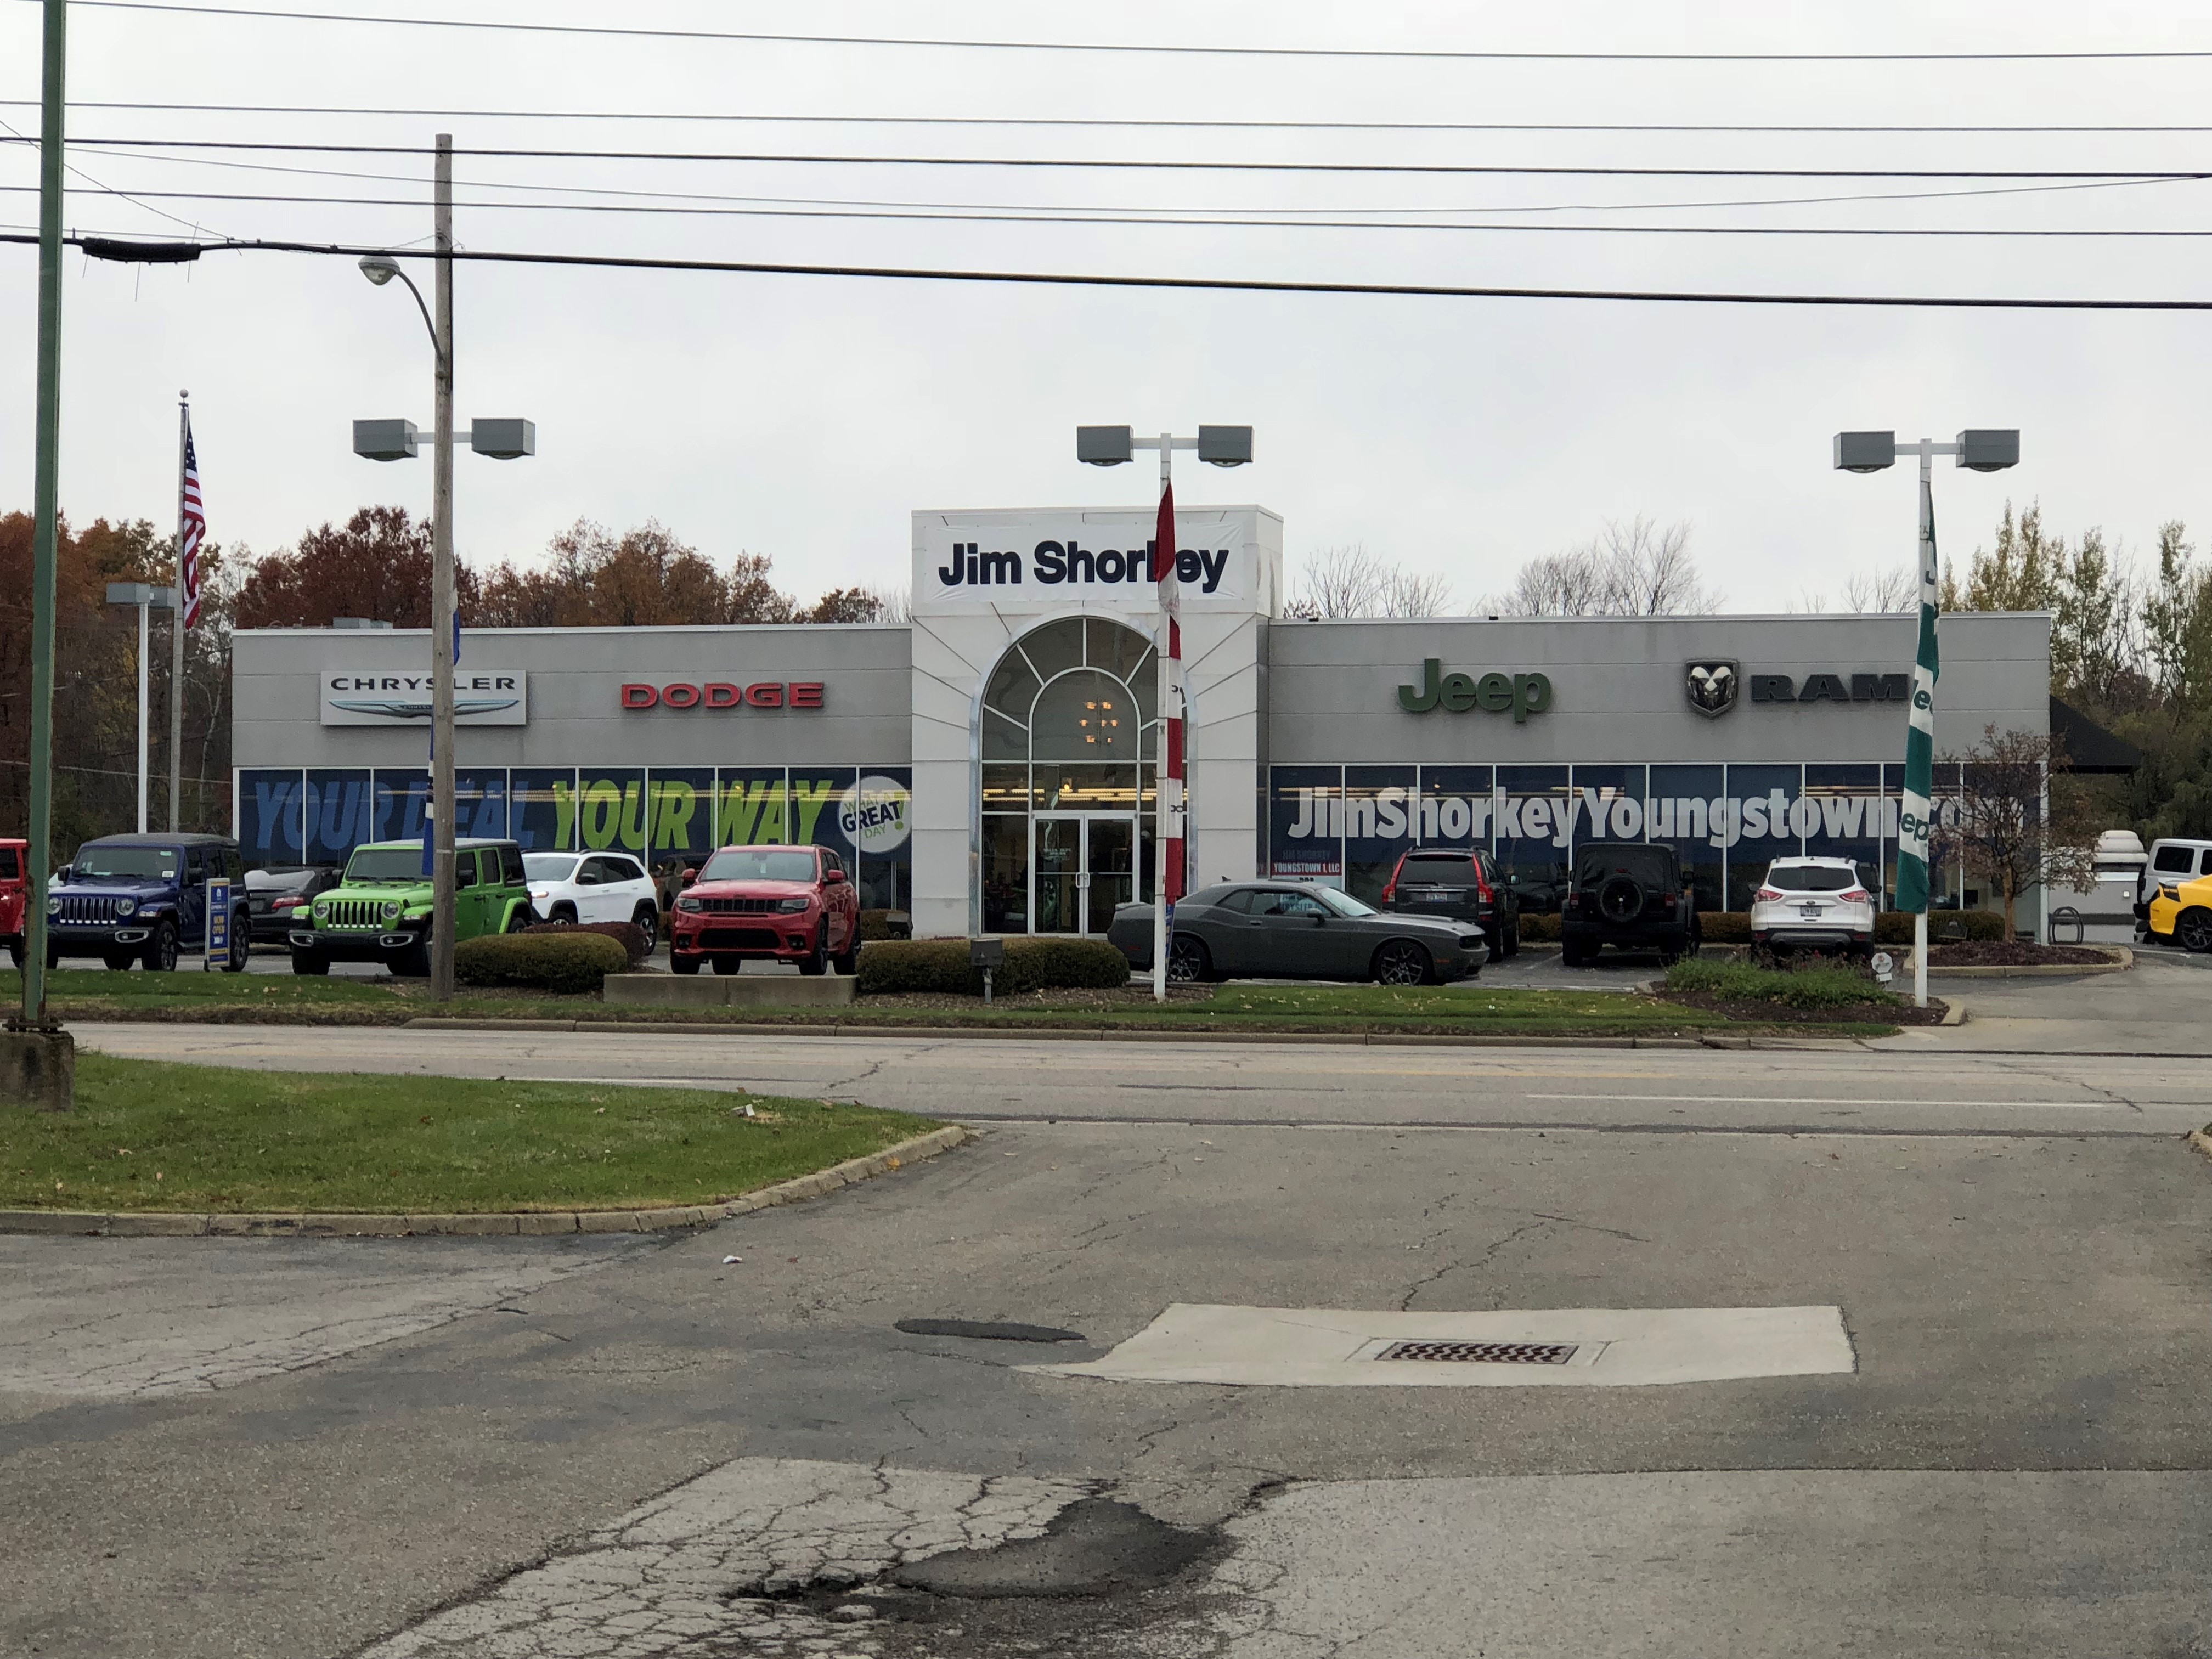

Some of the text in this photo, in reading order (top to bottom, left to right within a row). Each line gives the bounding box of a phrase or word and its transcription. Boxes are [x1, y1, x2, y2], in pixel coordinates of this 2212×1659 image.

[938, 542, 1022, 586] Jim
[621, 682, 824, 707] DODGE
[1398, 658, 1551, 723] Jeep
[1750, 673, 1909, 701] RAM
[255, 780, 394, 850] YOUR
[552, 780, 696, 850] YOUR
[709, 780, 834, 845] WAY
[864, 824, 886, 839] DAY
[1273, 862, 1321, 872] YOUNGSTOWN
[1328, 862, 1340, 873] LLC
